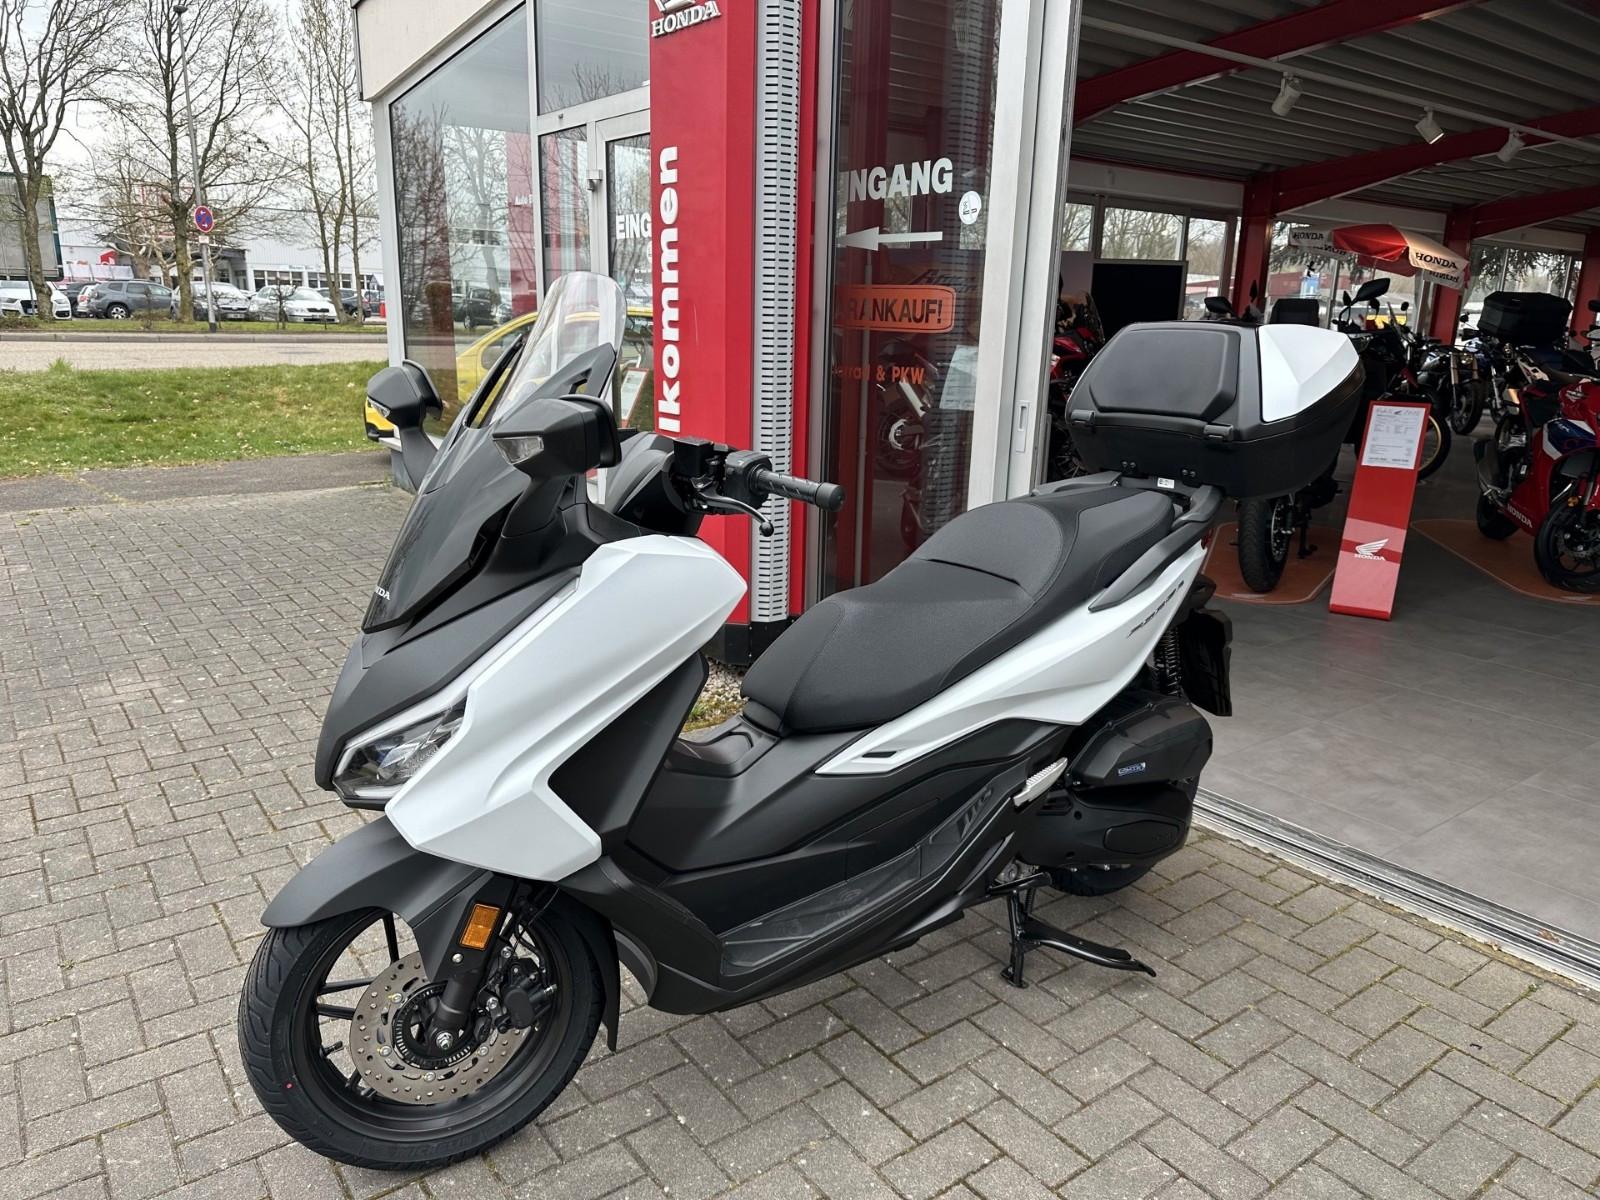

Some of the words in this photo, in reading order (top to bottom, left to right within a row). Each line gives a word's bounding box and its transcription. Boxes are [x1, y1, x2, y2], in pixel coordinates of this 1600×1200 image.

[651, 0, 721, 37] HONDA
[1293, 232, 1324, 240] HONDA
[1415, 252, 1458, 269] HONDA
[892, 365, 925, 385] PKW
[1507, 503, 1533, 528] HONDA
